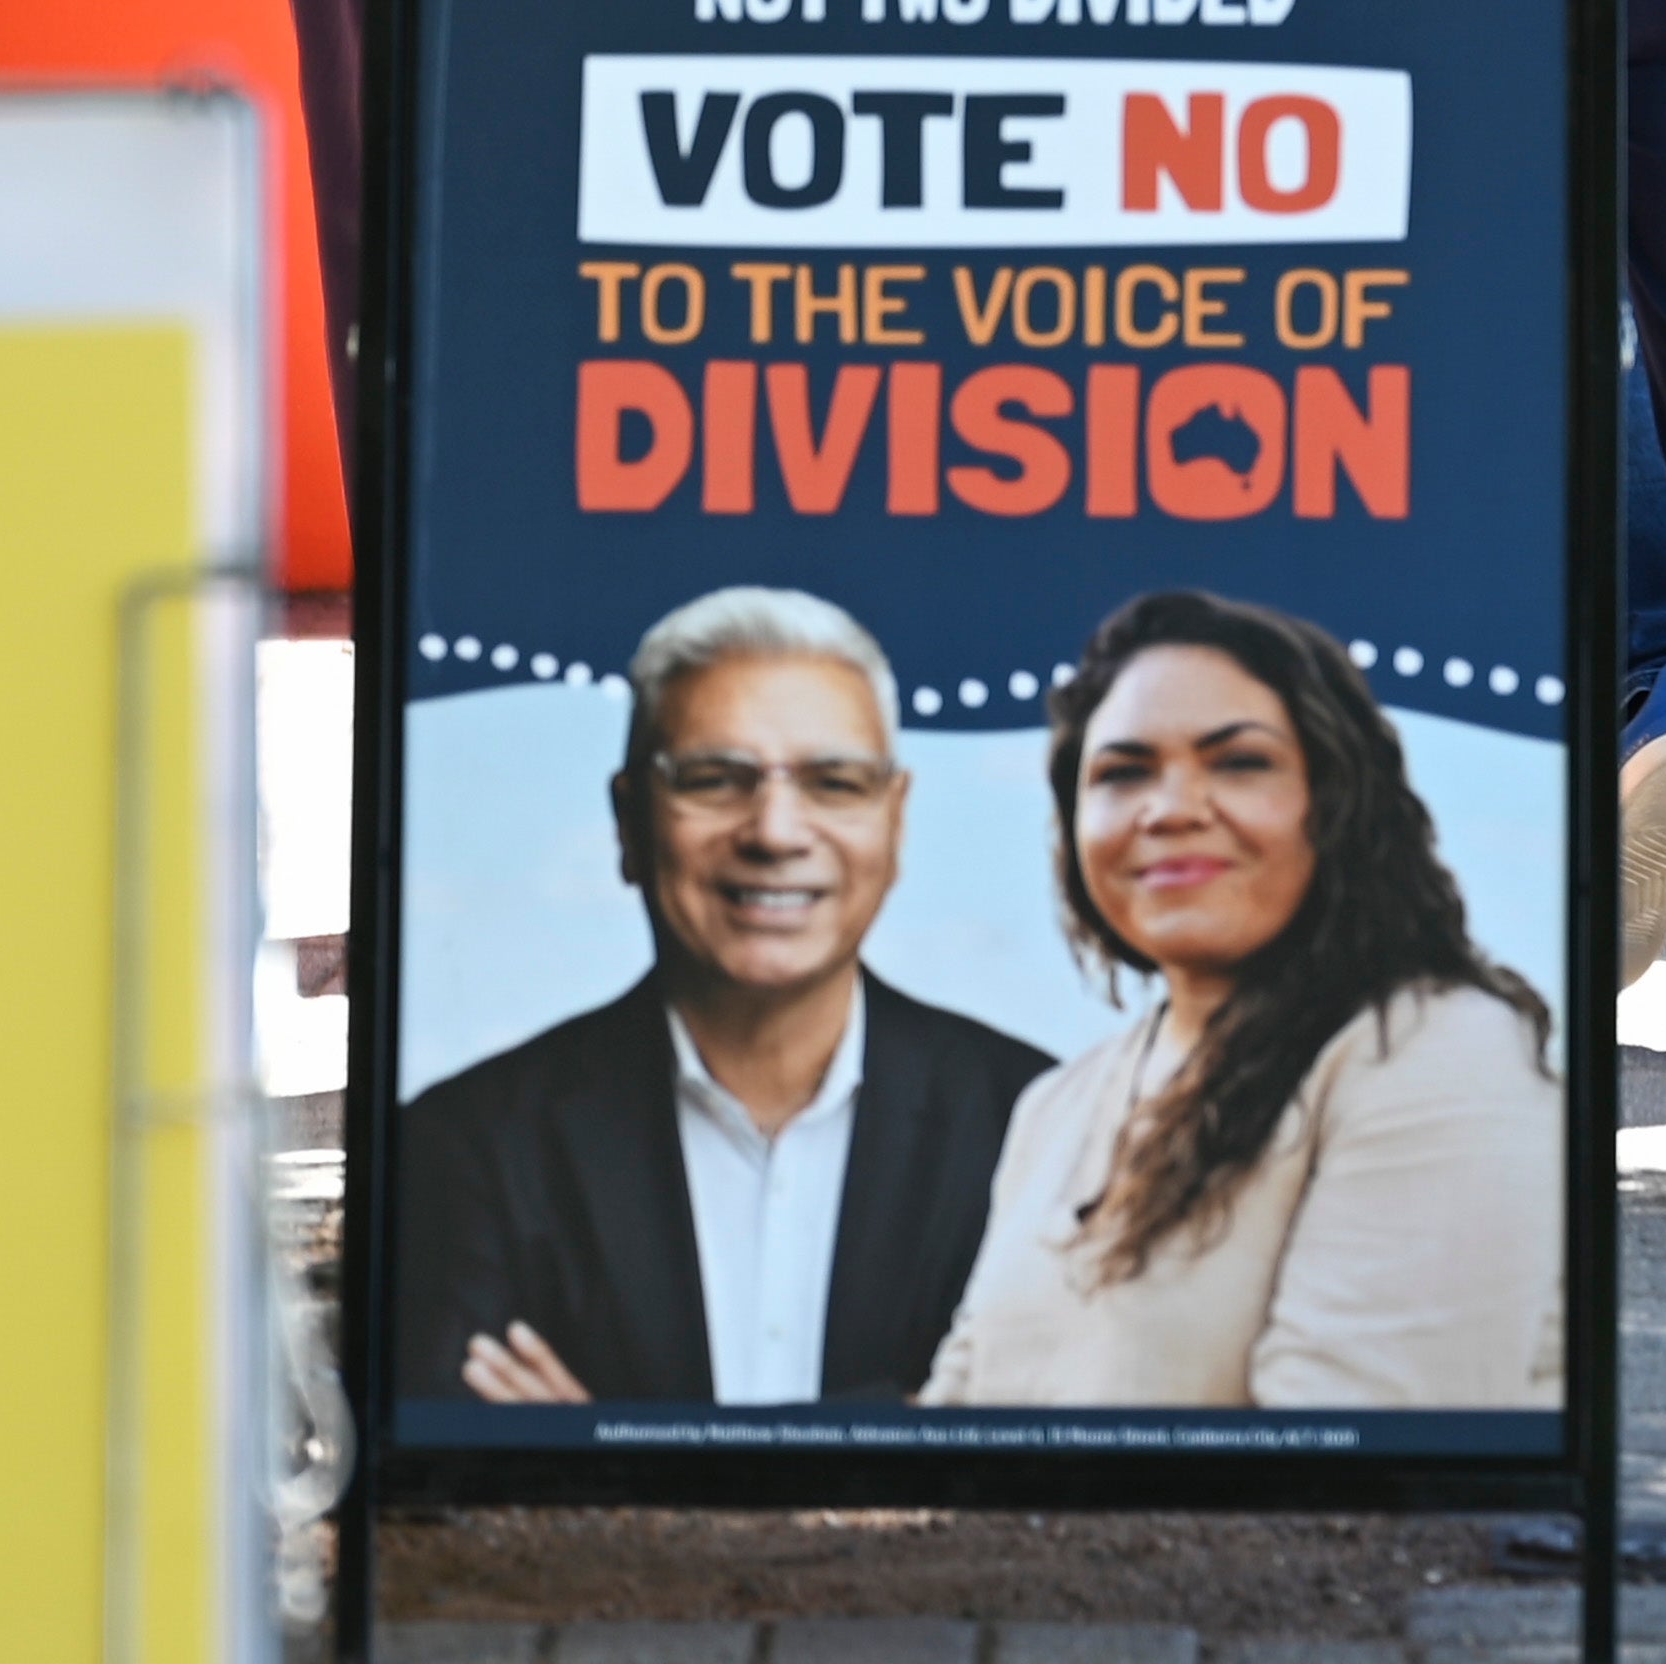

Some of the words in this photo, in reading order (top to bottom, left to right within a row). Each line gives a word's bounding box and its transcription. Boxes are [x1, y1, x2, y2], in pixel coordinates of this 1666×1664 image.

[638, 89, 1068, 212] VOTE
[1121, 91, 1343, 216] NO
[579, 262, 705, 344] TO
[731, 262, 926, 345] THE
[953, 266, 1246, 348] VOICE
[1275, 268, 1409, 350] OF
[576, 359, 1411, 521] DIVISION
